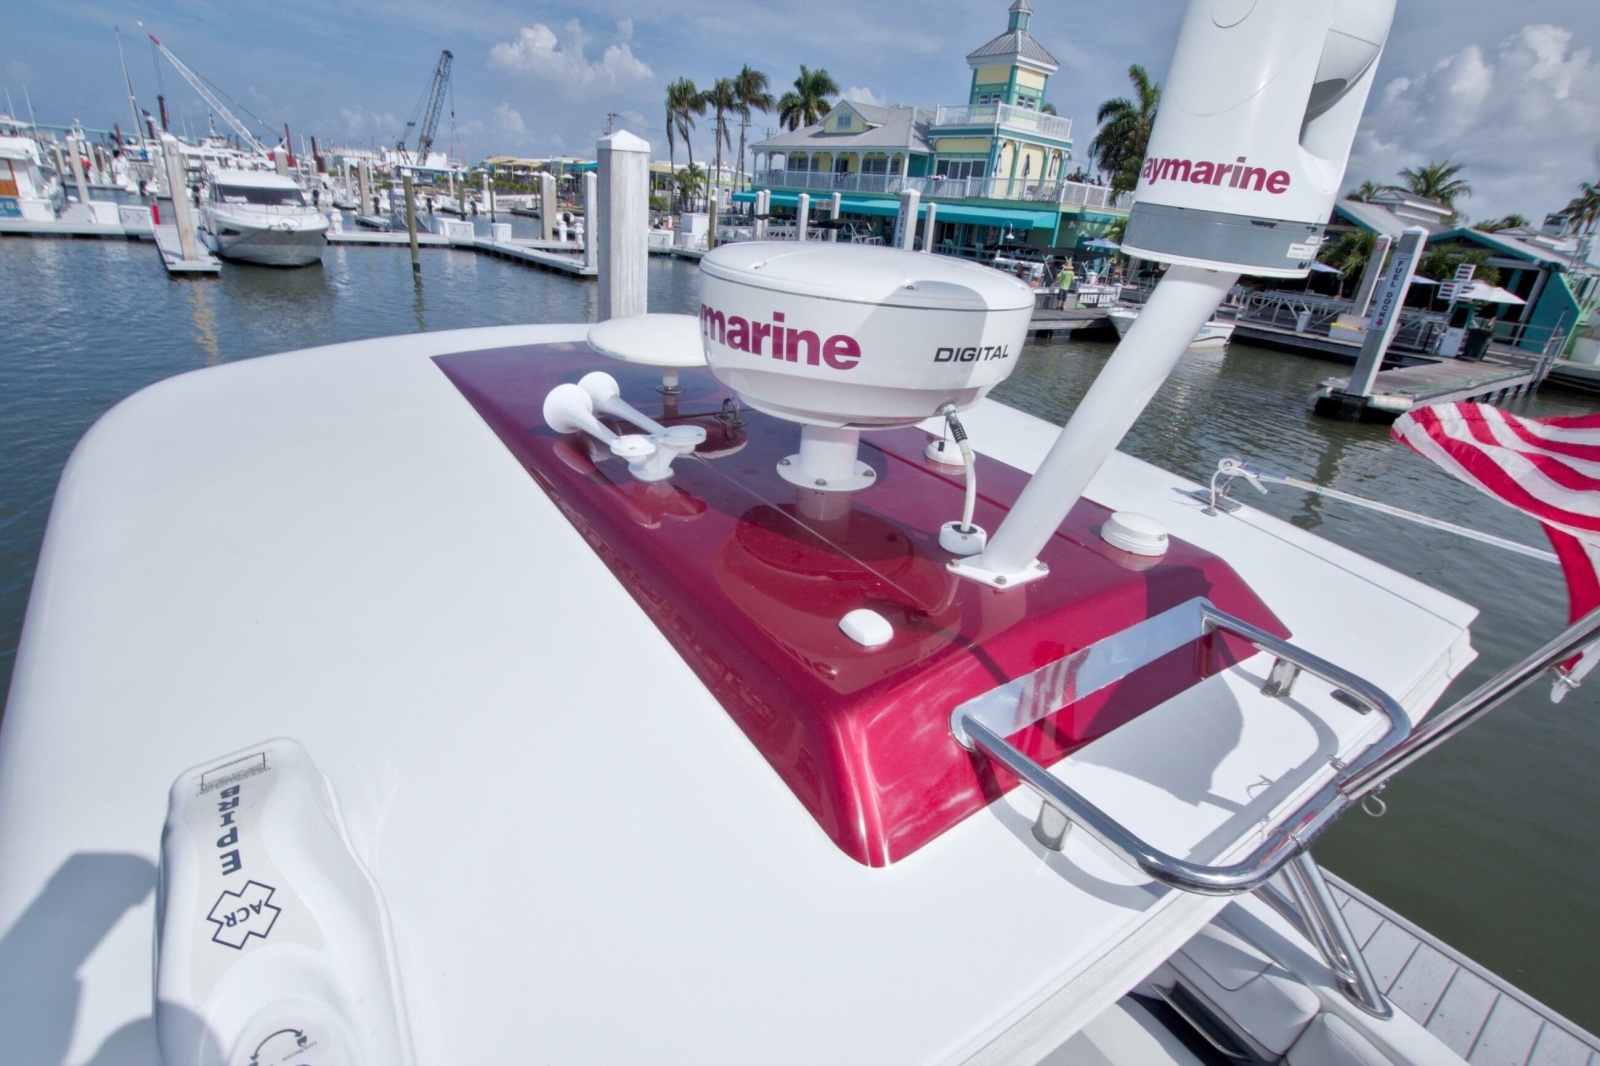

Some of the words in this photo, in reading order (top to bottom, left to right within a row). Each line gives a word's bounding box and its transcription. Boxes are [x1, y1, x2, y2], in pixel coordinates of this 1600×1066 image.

[1141, 156, 1291, 195] aymarine
[1391, 260, 1405, 288] FUEL
[1379, 292, 1393, 318] DOCK
[701, 302, 861, 370] marine
[934, 345, 1008, 363] DIGITAL
[216, 784, 242, 876] EPIRB
[223, 899, 263, 928] ACR
